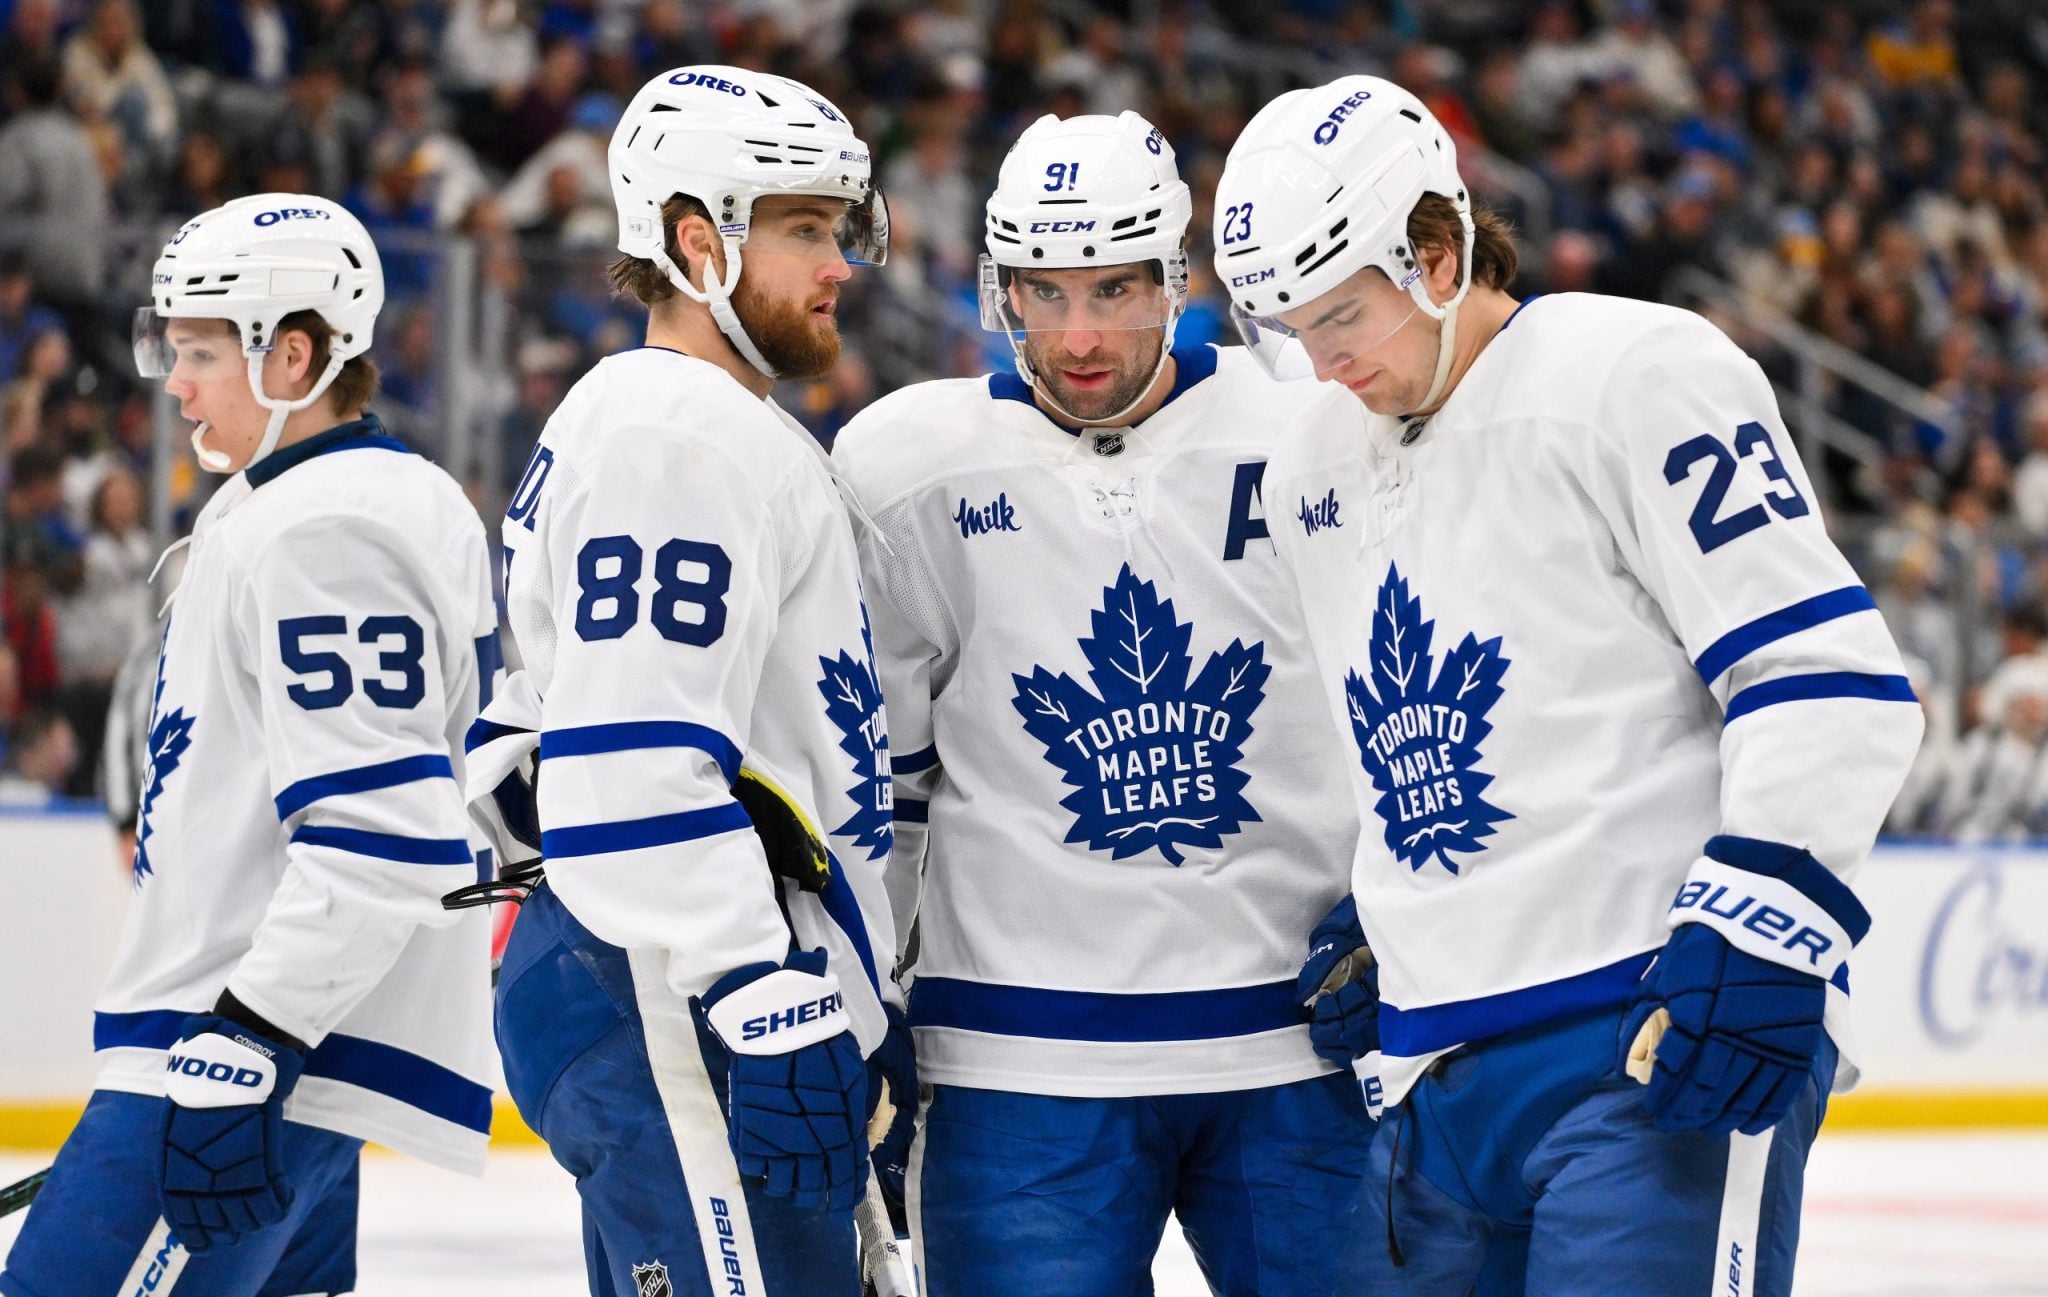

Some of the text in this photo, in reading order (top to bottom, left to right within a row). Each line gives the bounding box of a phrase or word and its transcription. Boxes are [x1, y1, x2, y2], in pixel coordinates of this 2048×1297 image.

[668, 72, 746, 97] OREO
[1313, 91, 1371, 146] OREO
[1043, 163, 1079, 192] 91
[254, 208, 331, 227] OREO
[1030, 220, 1096, 234] CCM
[1223, 202, 1254, 245] 23
[1231, 267, 1276, 288] CCM
[1100, 439, 1119, 453] NHL
[1663, 421, 1809, 555] 23
[1223, 461, 1276, 560] A
[574, 534, 732, 648] 88
[278, 615, 425, 711] 53
[1065, 702, 1231, 760] TORONTO
[1366, 703, 1467, 765] TORONTO
[1097, 740, 1213, 782] MAPLE
[1388, 743, 1454, 788] MAPLE
[1102, 774, 1216, 815] LEAFS
[1397, 777, 1463, 823] LEAFS
[1668, 880, 1833, 966] AUER
[235, 1034, 276, 1058] COWBOY
